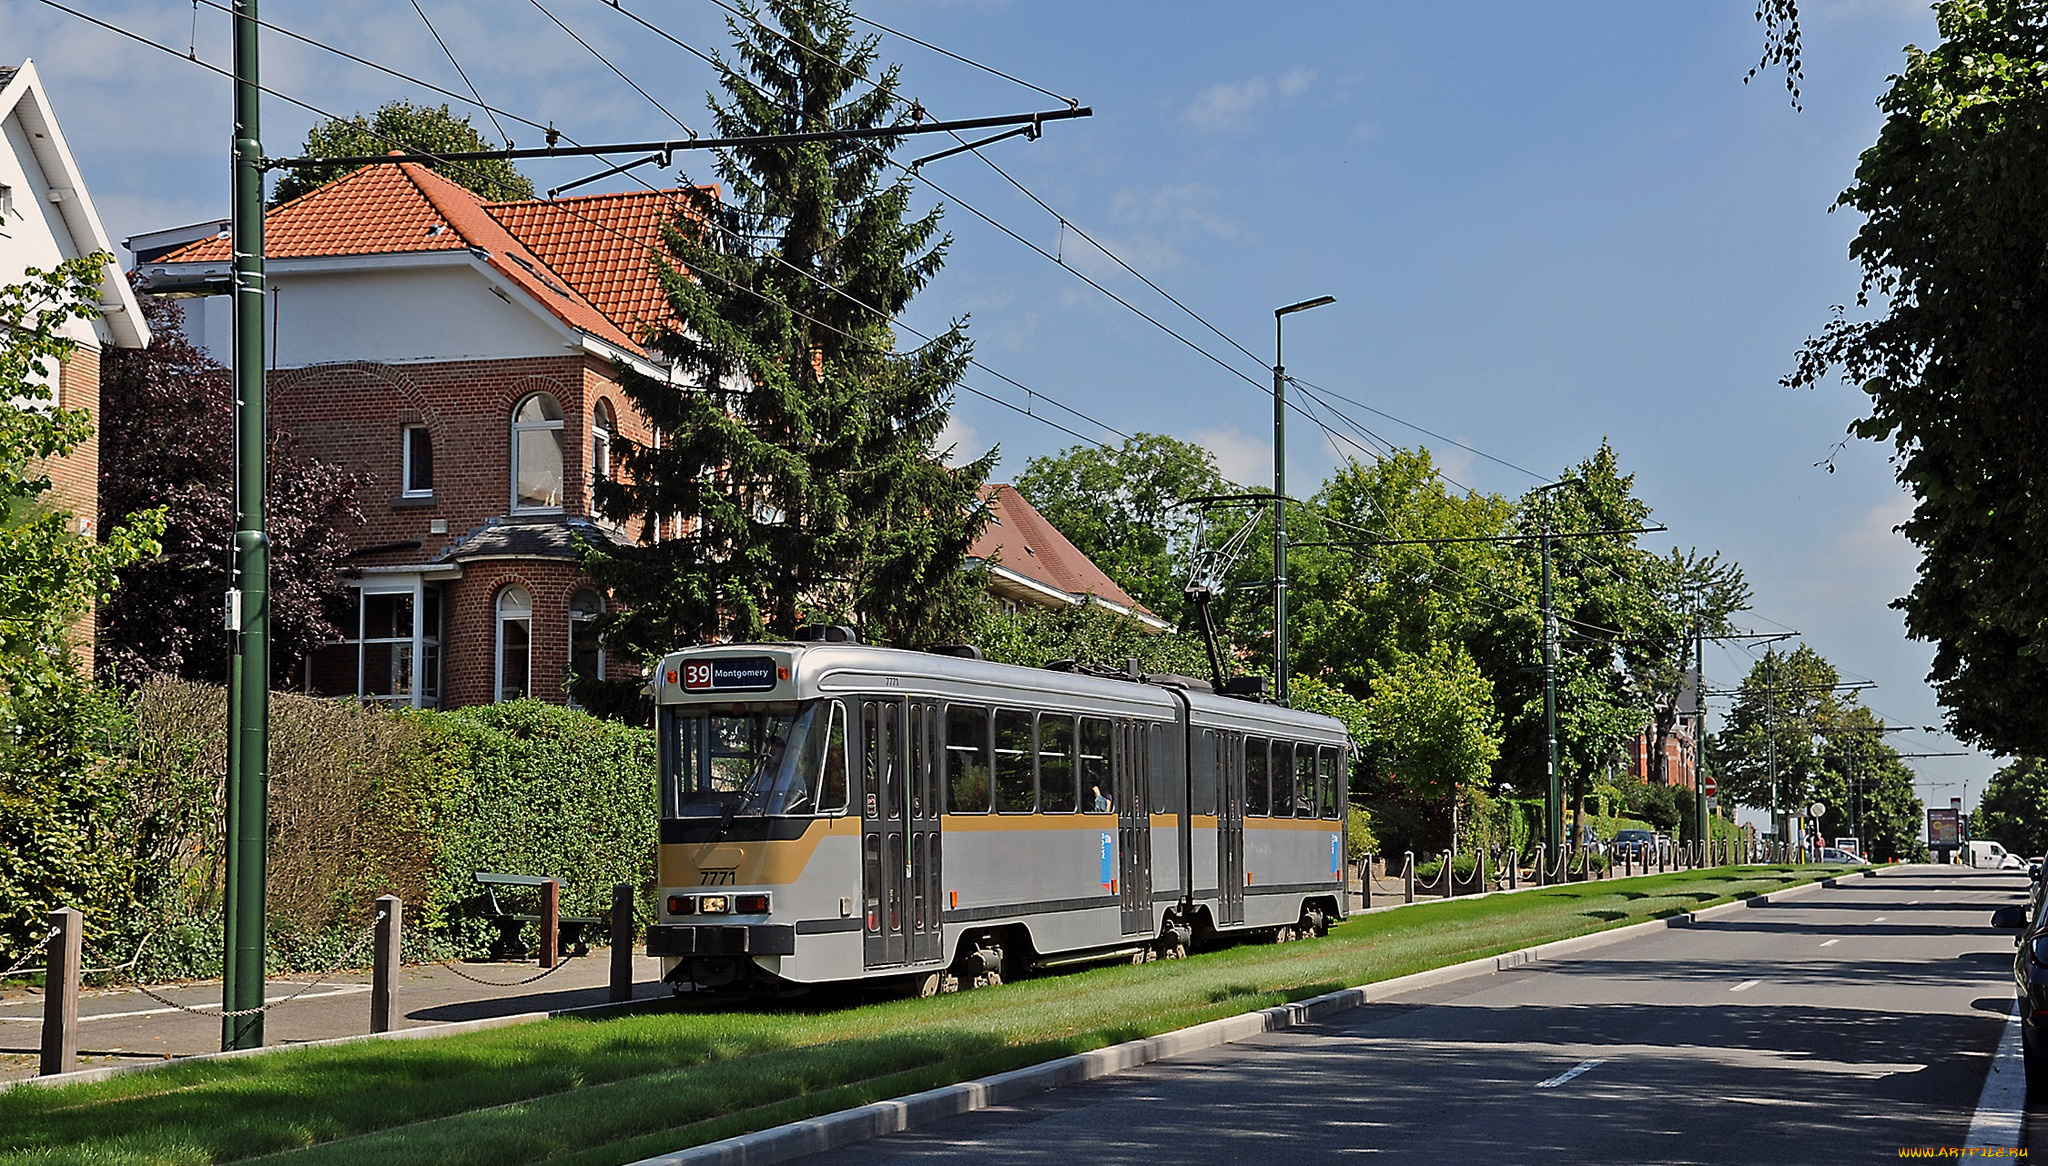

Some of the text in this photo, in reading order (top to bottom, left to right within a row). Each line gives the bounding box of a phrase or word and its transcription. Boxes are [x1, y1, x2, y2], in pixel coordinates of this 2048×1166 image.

[687, 666, 769, 683] 39 Montgomery
[885, 677, 899, 687] 7771
[701, 872, 735, 885] 7771
